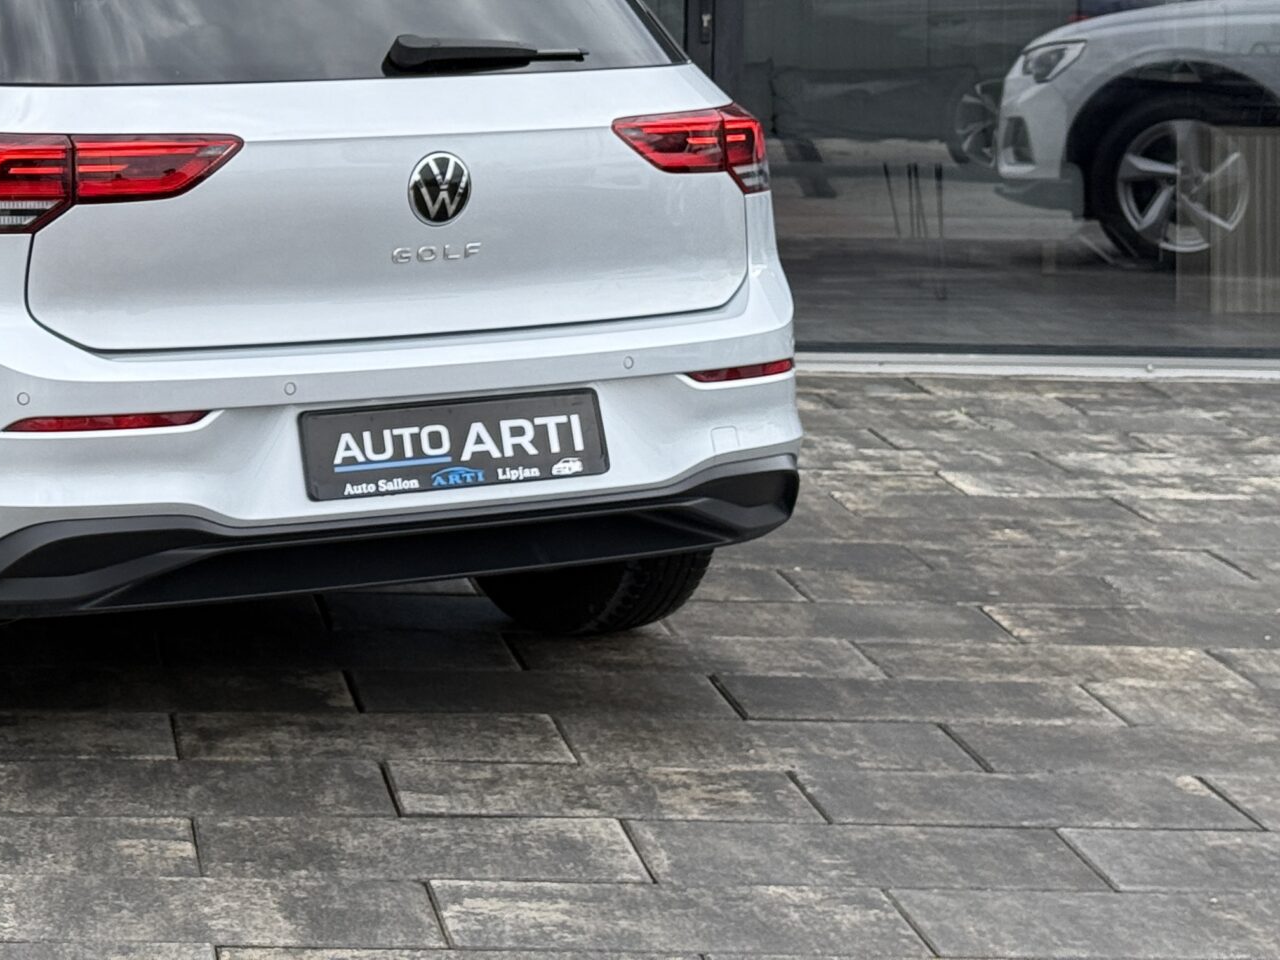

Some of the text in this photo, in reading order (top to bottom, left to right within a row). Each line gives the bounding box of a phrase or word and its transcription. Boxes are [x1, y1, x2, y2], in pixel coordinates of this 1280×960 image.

[392, 242, 482, 264] GOLF
[333, 414, 585, 465] AUTO ARTI
[343, 466, 541, 496] Auto Sallon ARTI Lipjan
